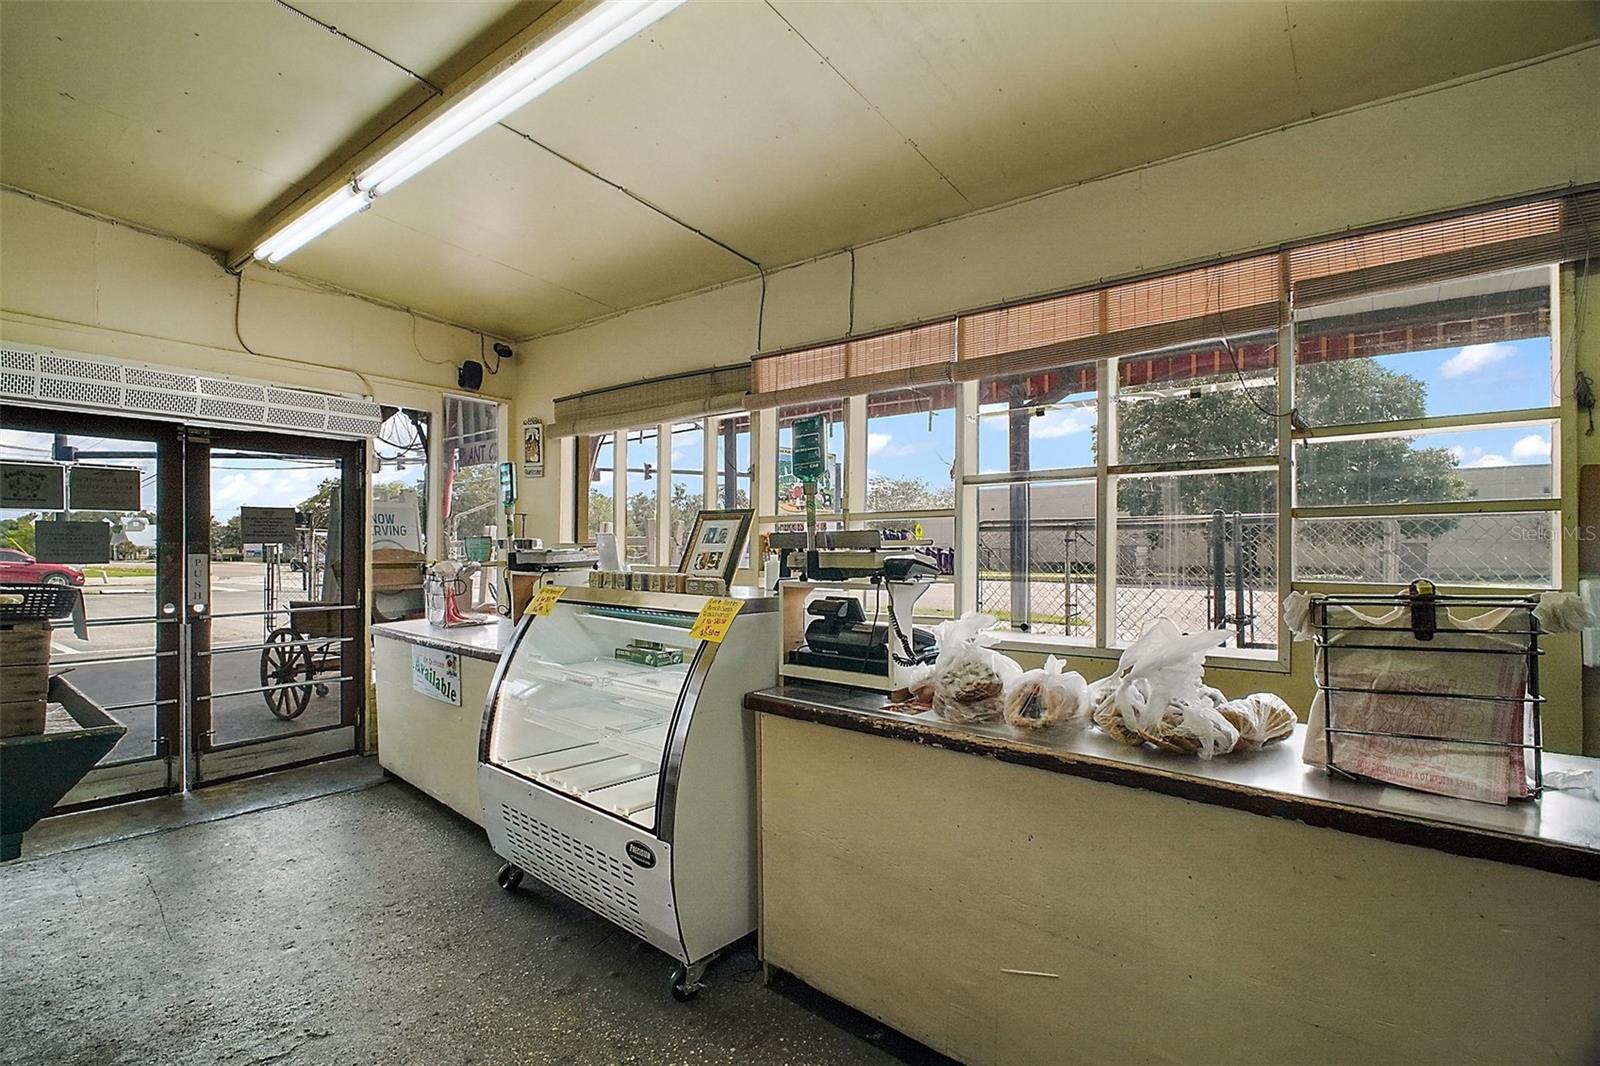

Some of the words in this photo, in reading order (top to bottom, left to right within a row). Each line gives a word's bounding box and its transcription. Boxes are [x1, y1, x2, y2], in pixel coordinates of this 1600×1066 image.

[373, 525, 407, 536] RVING
[194, 560, 202, 599] PUSH
[415, 656, 457, 702] Available
